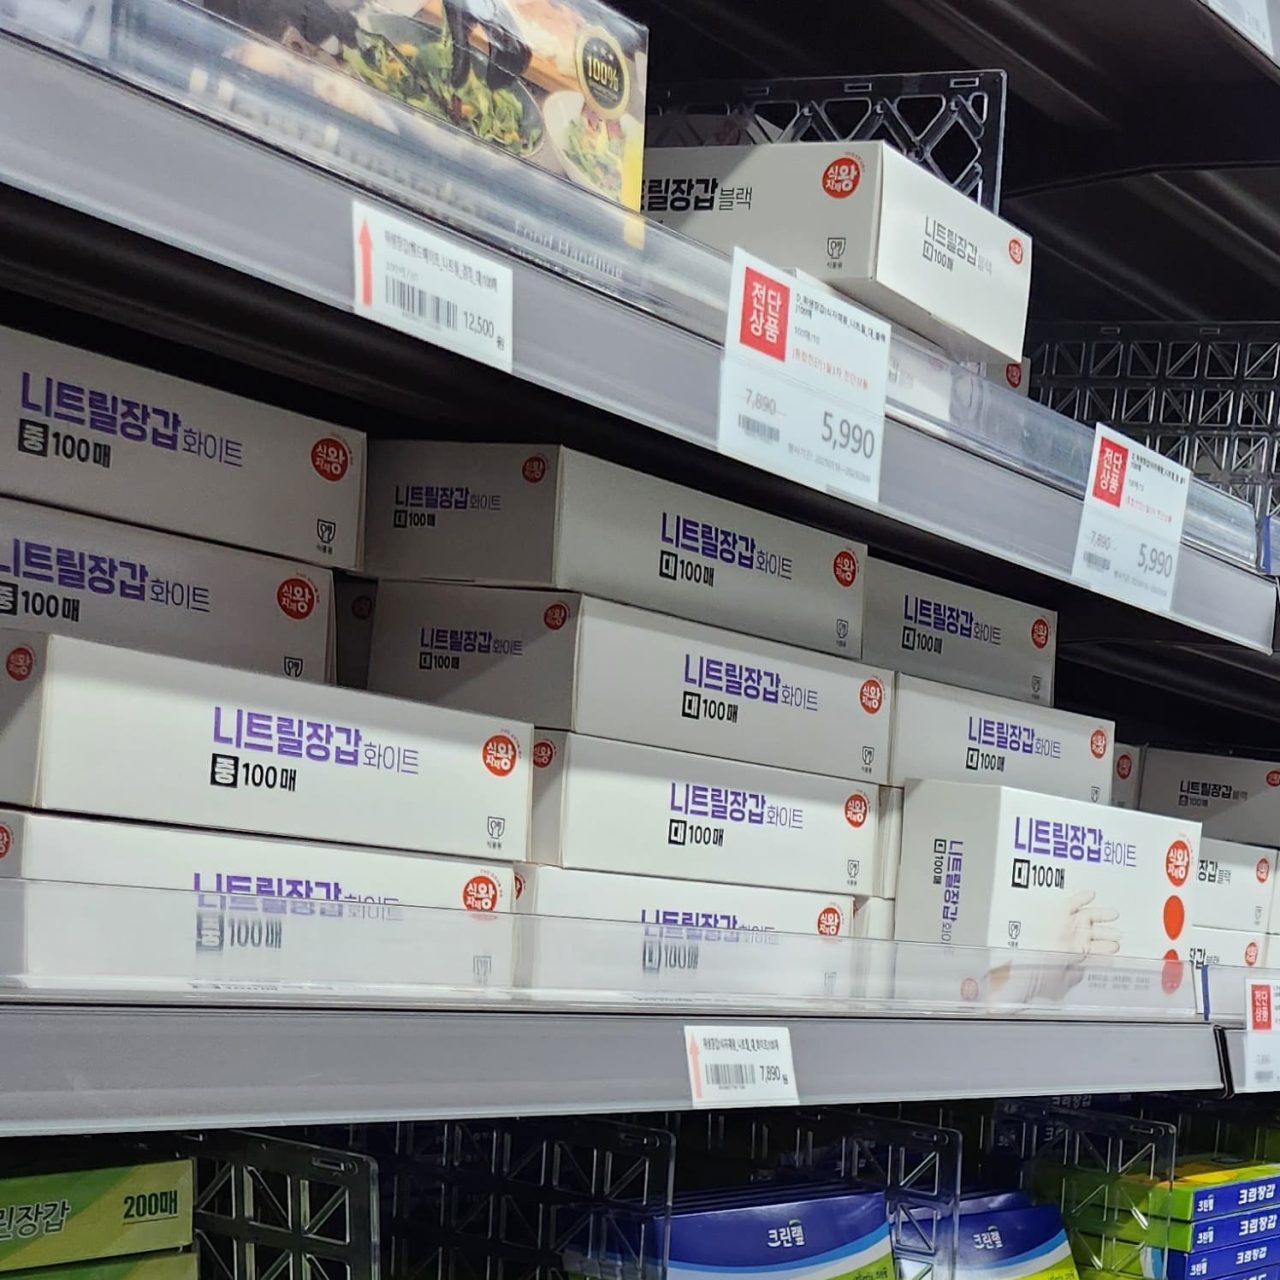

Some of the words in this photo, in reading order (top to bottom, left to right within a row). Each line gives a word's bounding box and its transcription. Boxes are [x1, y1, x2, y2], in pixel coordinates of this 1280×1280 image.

[587, 54, 619, 92] 100%
[751, 281, 783, 314] 전단
[463, 311, 495, 339] 12,500
[749, 313, 780, 344] 상품
[745, 387, 778, 416] 7,890
[21, 372, 181, 450] 니트릴장갑
[183, 428, 243, 468] 화이트
[821, 410, 876, 460] 5,990
[51, 431, 112, 469] 100매
[1100, 448, 1124, 475] 전단
[394, 485, 470, 510] 니트릴장갑
[469, 493, 501, 512] 화이트
[1099, 473, 1119, 495] 상품
[659, 511, 756, 570] 니트릴장갑
[755, 549, 794, 581] 화이트
[1137, 542, 1174, 578] 5,990
[0, 538, 149, 601] 니트릴장갑
[150, 576, 210, 613] 화이트
[679, 558, 715, 587] 100매
[22, 590, 80, 623] 100매
[904, 594, 974, 639] 니트릴장갑
[973, 623, 1002, 646] 화이트
[420, 628, 492, 655] 니트릴장갑
[684, 654, 782, 704] 니트릴장갑
[781, 683, 819, 712] 화이트
[701, 698, 739, 724] 100매
[213, 706, 363, 767] 니트릴장갑
[363, 742, 419, 775] 화이트
[968, 716, 1035, 755] 니트릴장갑
[1034, 737, 1061, 760] 화이트
[241, 761, 297, 793] 100매
[1180, 779, 1232, 799] 니트릴장갑
[671, 782, 766, 825] 니트릴장갑
[766, 805, 804, 829] 화이트
[688, 824, 724, 848] 100매
[1014, 816, 1103, 863] 니트릴장갑
[1102, 841, 1137, 868] 화이트
[942, 840, 964, 922] 니트릴장갑
[1031, 864, 1065, 890] 100매
[122, 1189, 178, 1220] 200매
[1238, 1183, 1276, 1205] 크린장갑
[1239, 1214, 1278, 1236] 크린장갑
[1236, 1246, 1268, 1265] 크린장갑
